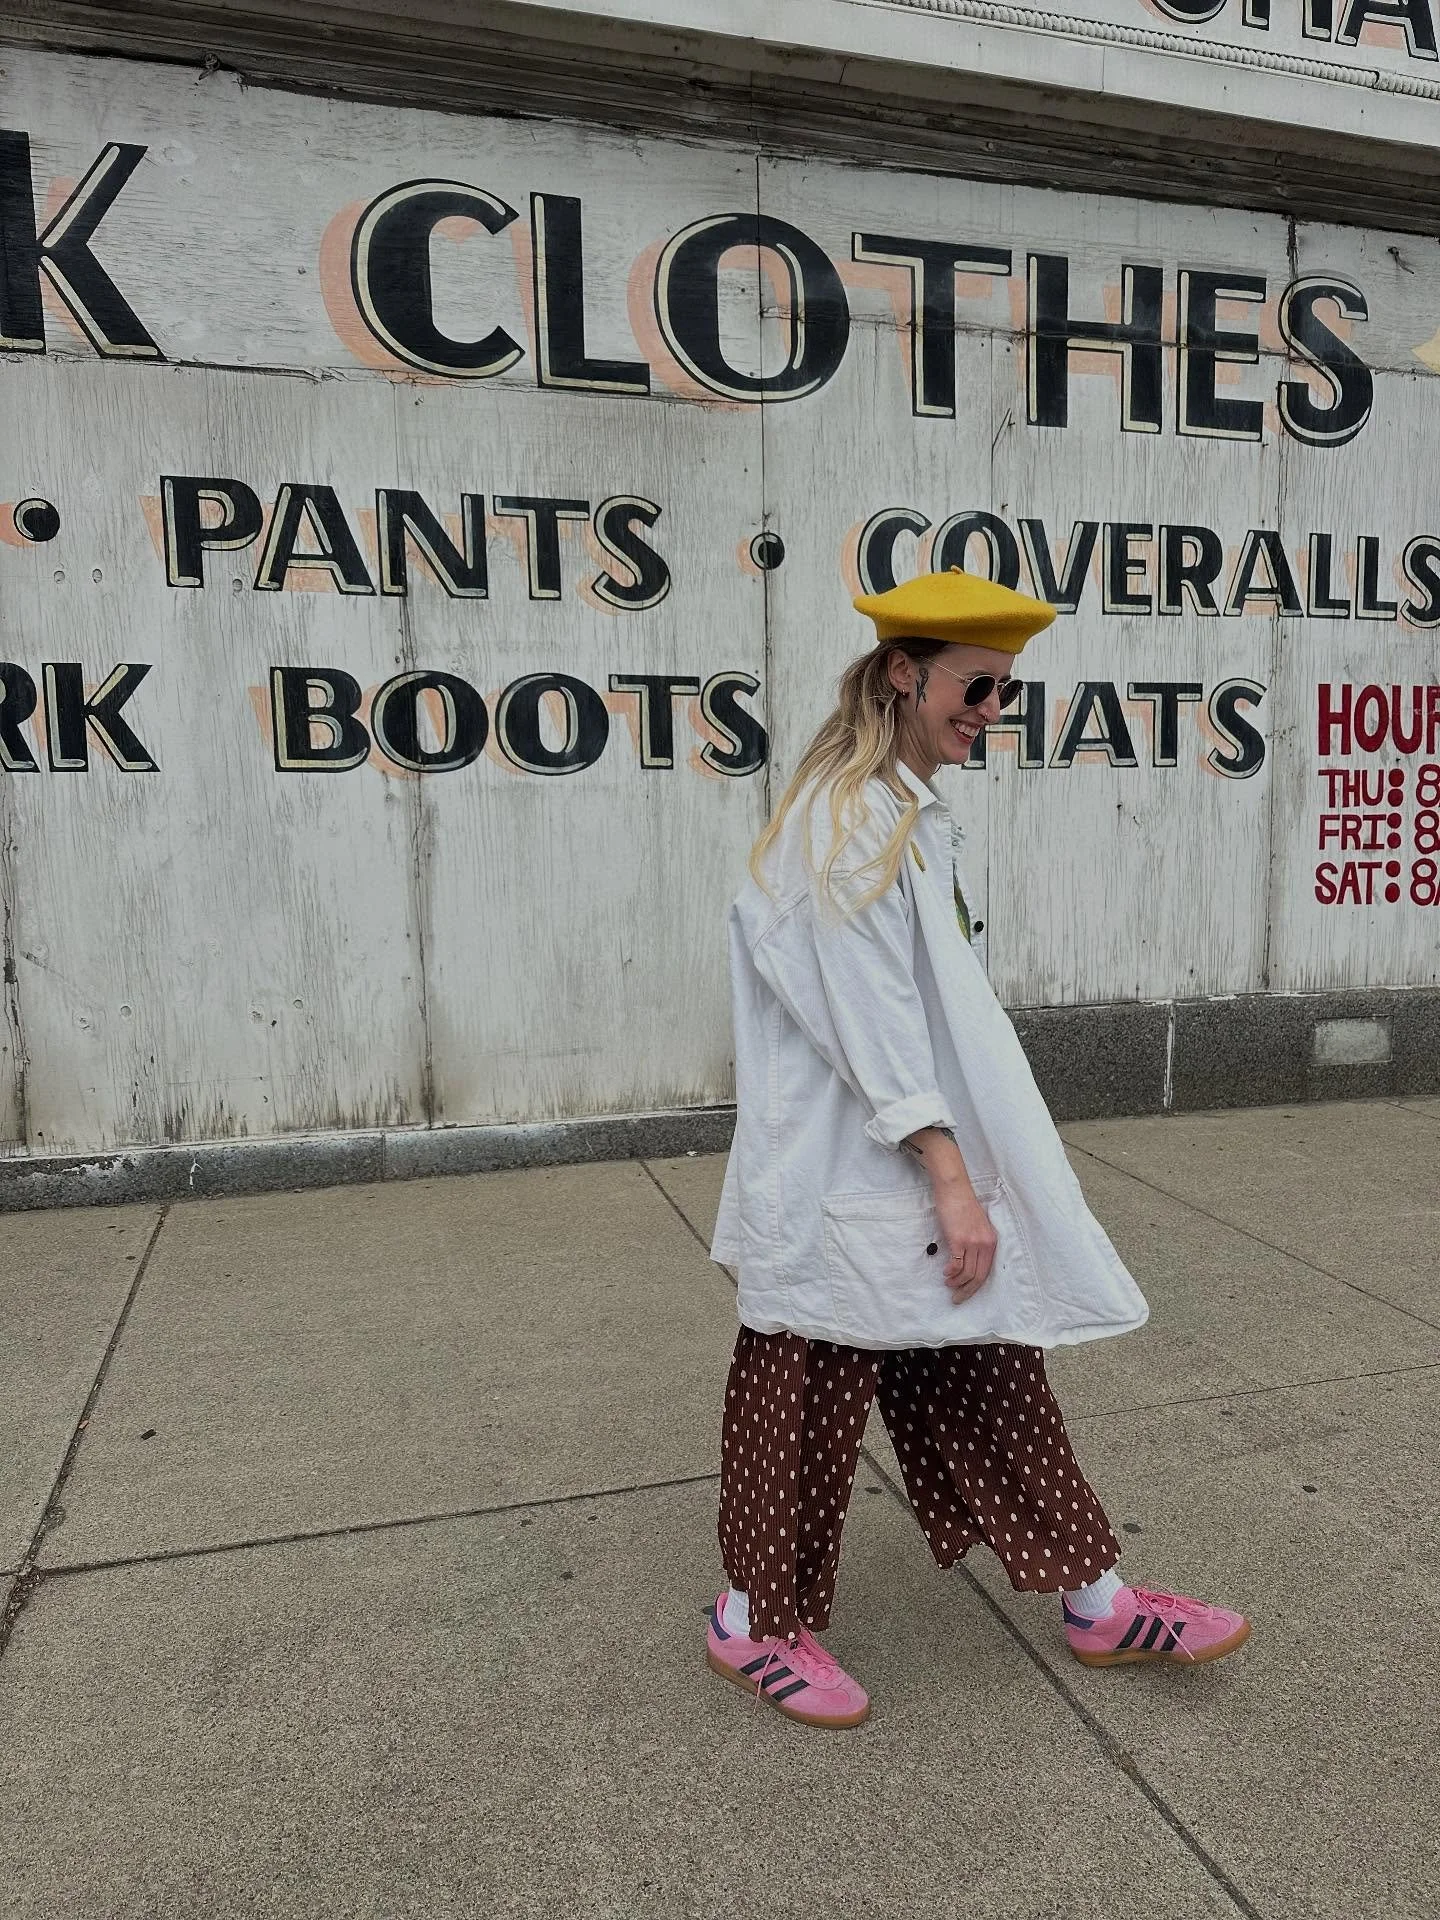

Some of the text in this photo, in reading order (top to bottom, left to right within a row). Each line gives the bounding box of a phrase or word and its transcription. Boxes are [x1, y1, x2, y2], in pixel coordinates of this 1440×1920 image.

[349, 177, 1374, 450] CLOTHES
[160, 475, 1440, 629] PANTS COVERALLS
[269, 666, 770, 777] BOOTS
[960, 677, 1268, 781] HATS
[1317, 763, 1440, 808] THU: 8
[1318, 809, 1440, 855] FRI: 8
[1314, 857, 1440, 907] SAT: 8
